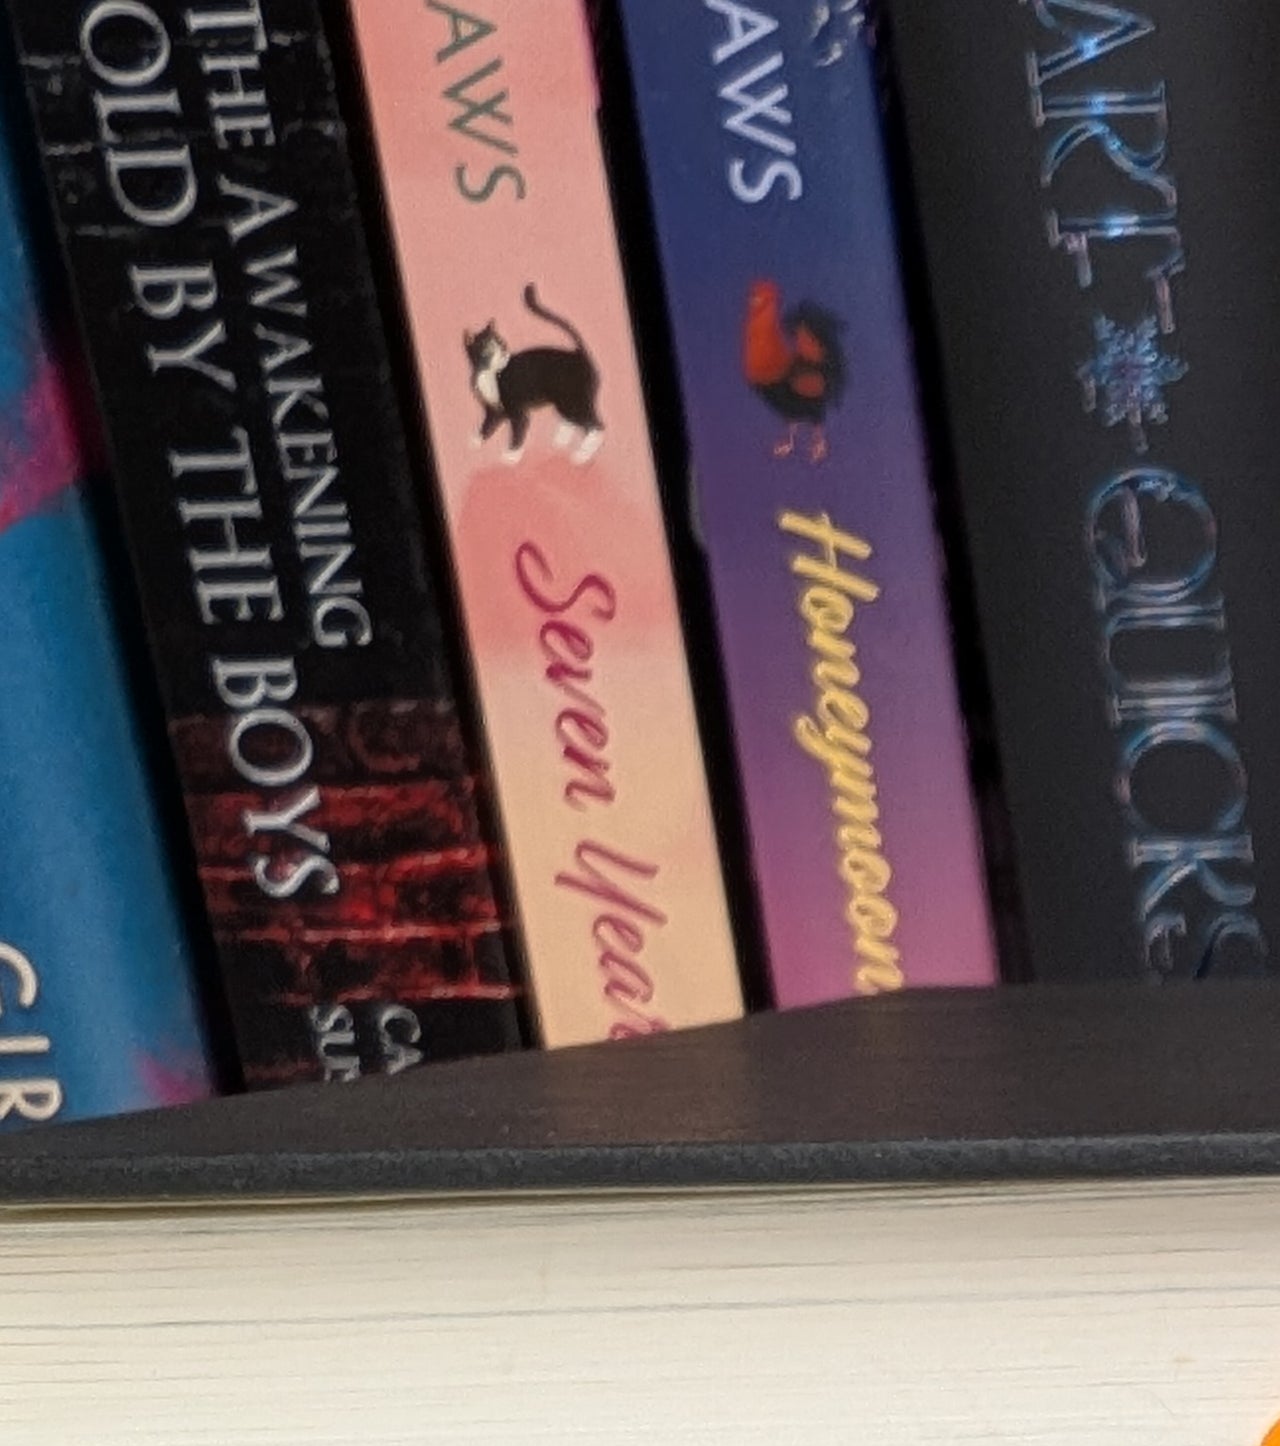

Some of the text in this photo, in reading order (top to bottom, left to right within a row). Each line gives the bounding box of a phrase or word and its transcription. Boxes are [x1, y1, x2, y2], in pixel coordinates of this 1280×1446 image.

[130, 262, 238, 393] BY
[184, 0, 373, 648] THE AWAKENING
[168, 426, 287, 626] THE
[210, 656, 341, 898] BOYS
[515, 541, 617, 811] Seven
[778, 509, 903, 995] Honeymoon
